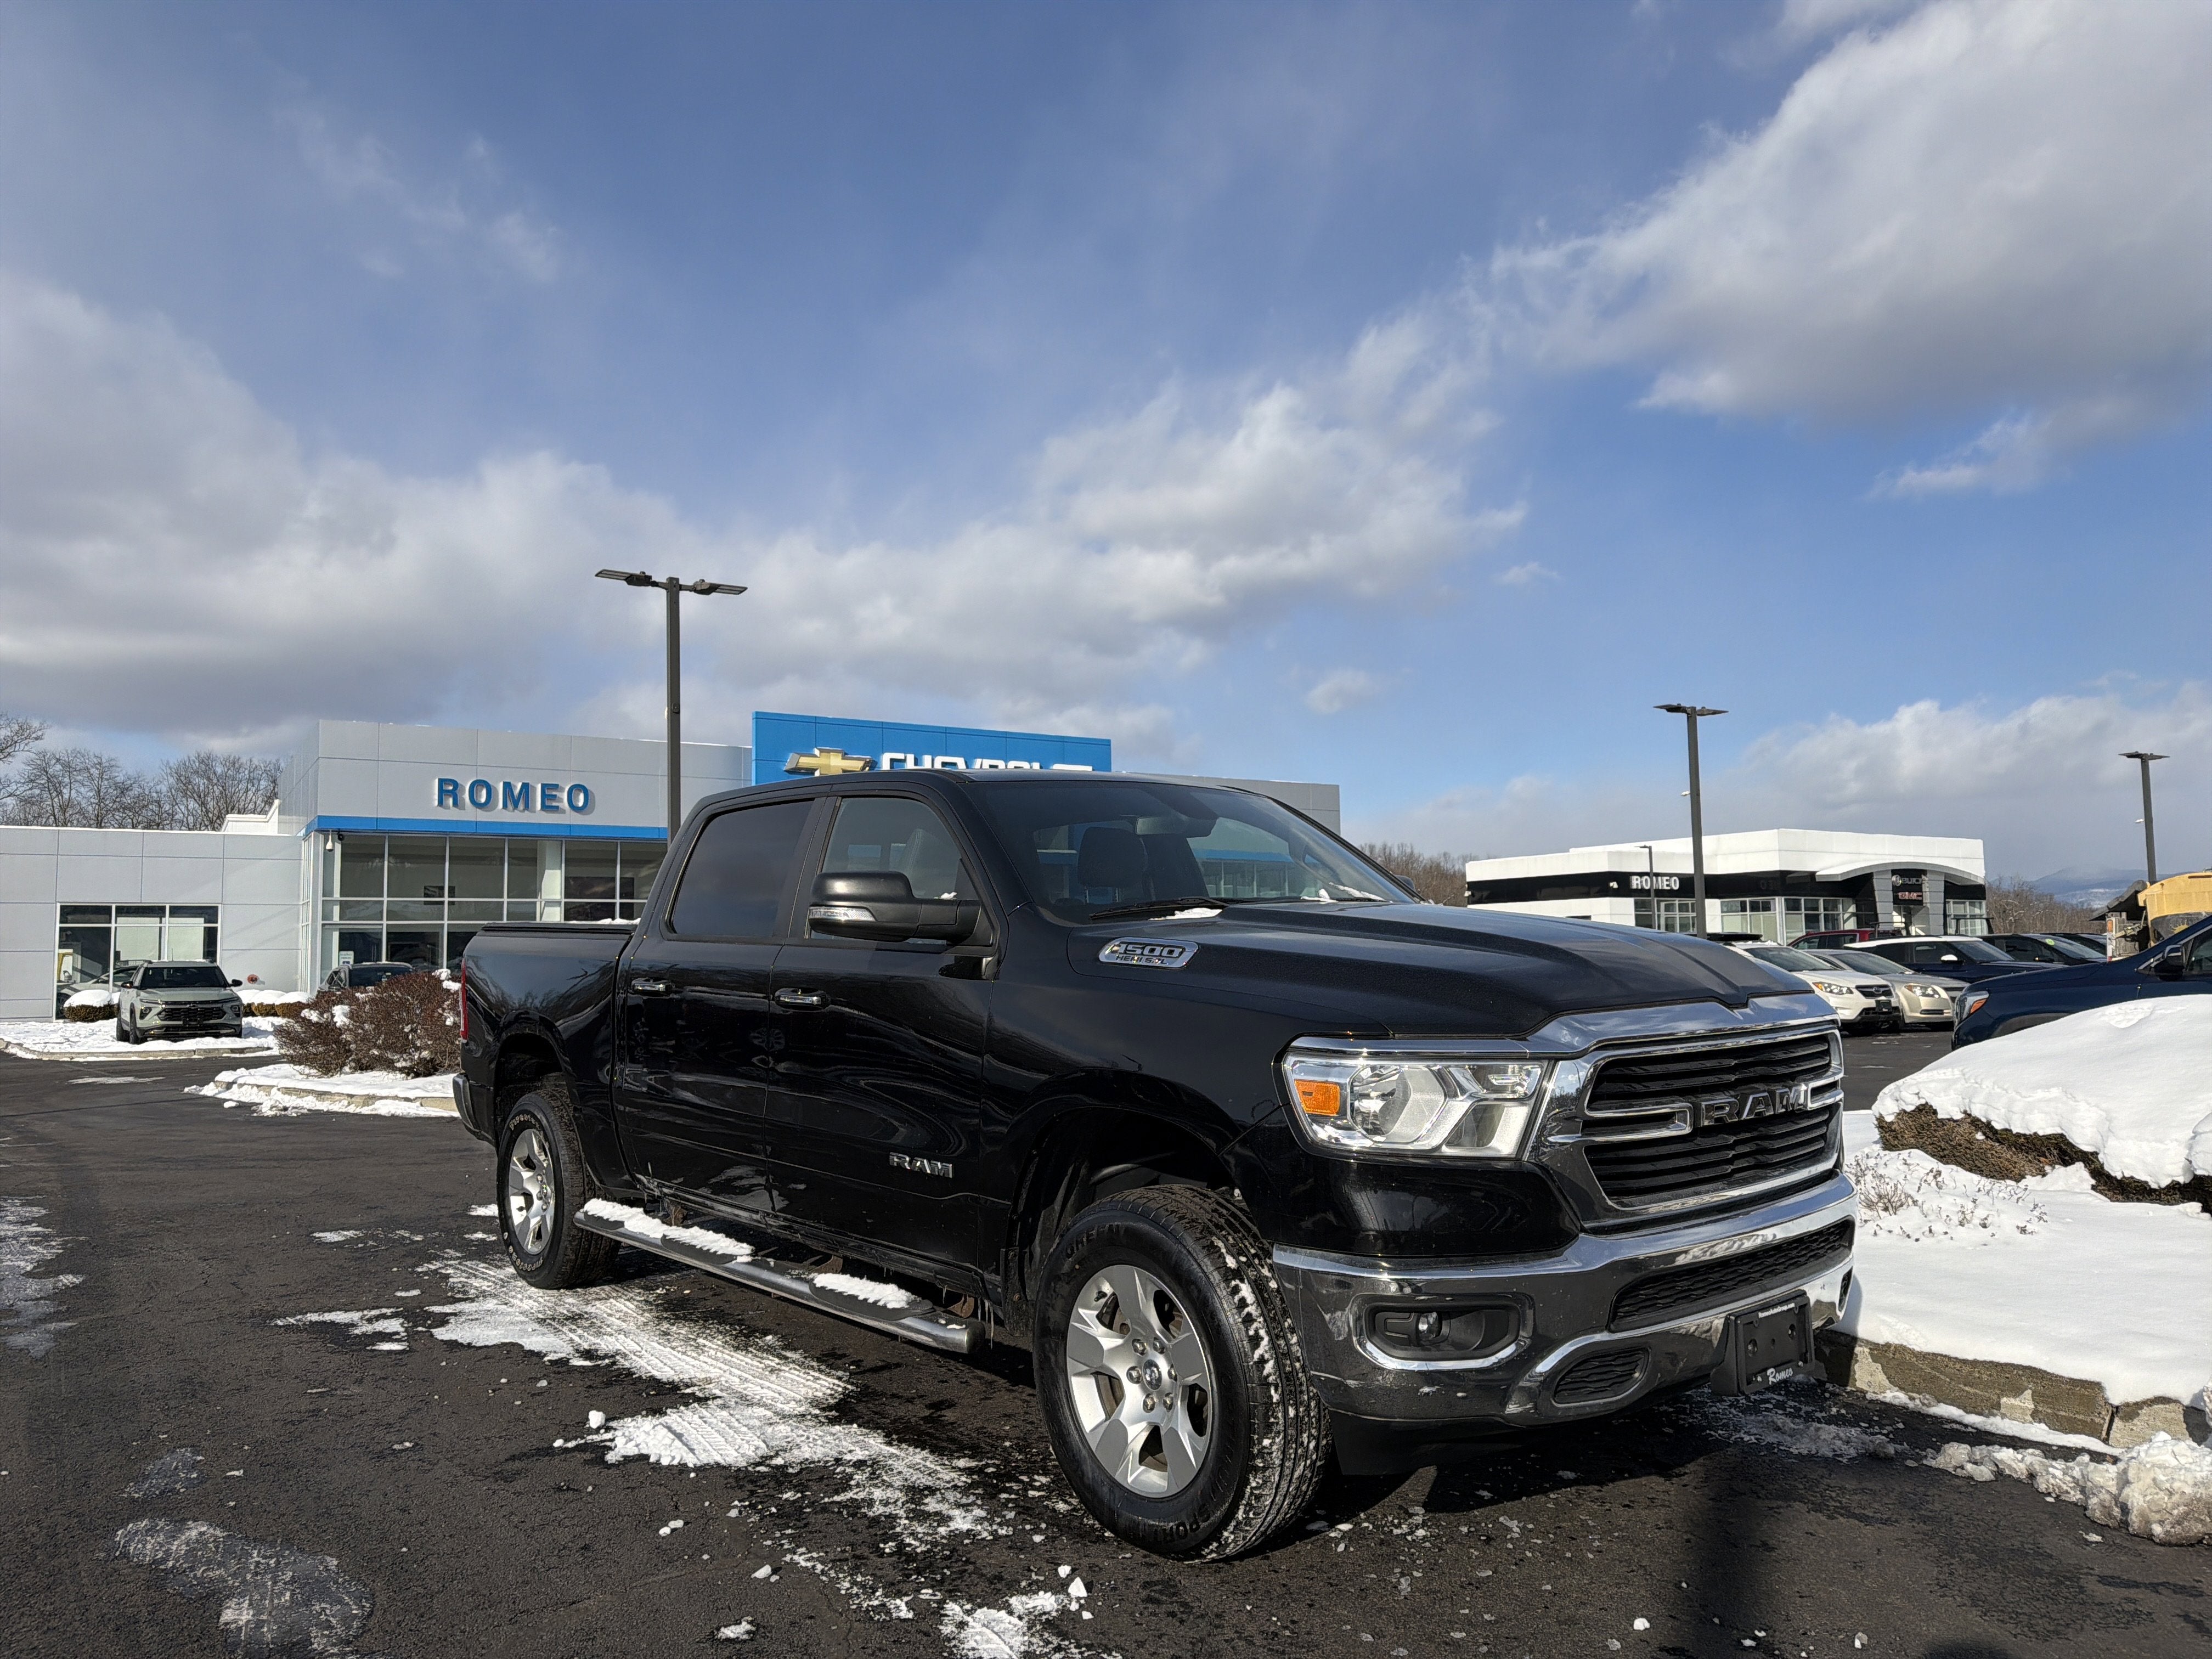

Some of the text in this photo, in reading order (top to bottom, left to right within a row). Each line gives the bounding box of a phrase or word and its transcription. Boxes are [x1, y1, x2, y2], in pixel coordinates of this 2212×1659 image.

[436, 777, 590, 811] ROMEO
[1630, 876, 1679, 890] ROMEO
[1111, 943, 1182, 957] 1500
[1700, 1083, 1808, 1127] RAM
[889, 1152, 952, 1178] RAM
[1767, 1368, 1793, 1385] Romeo
